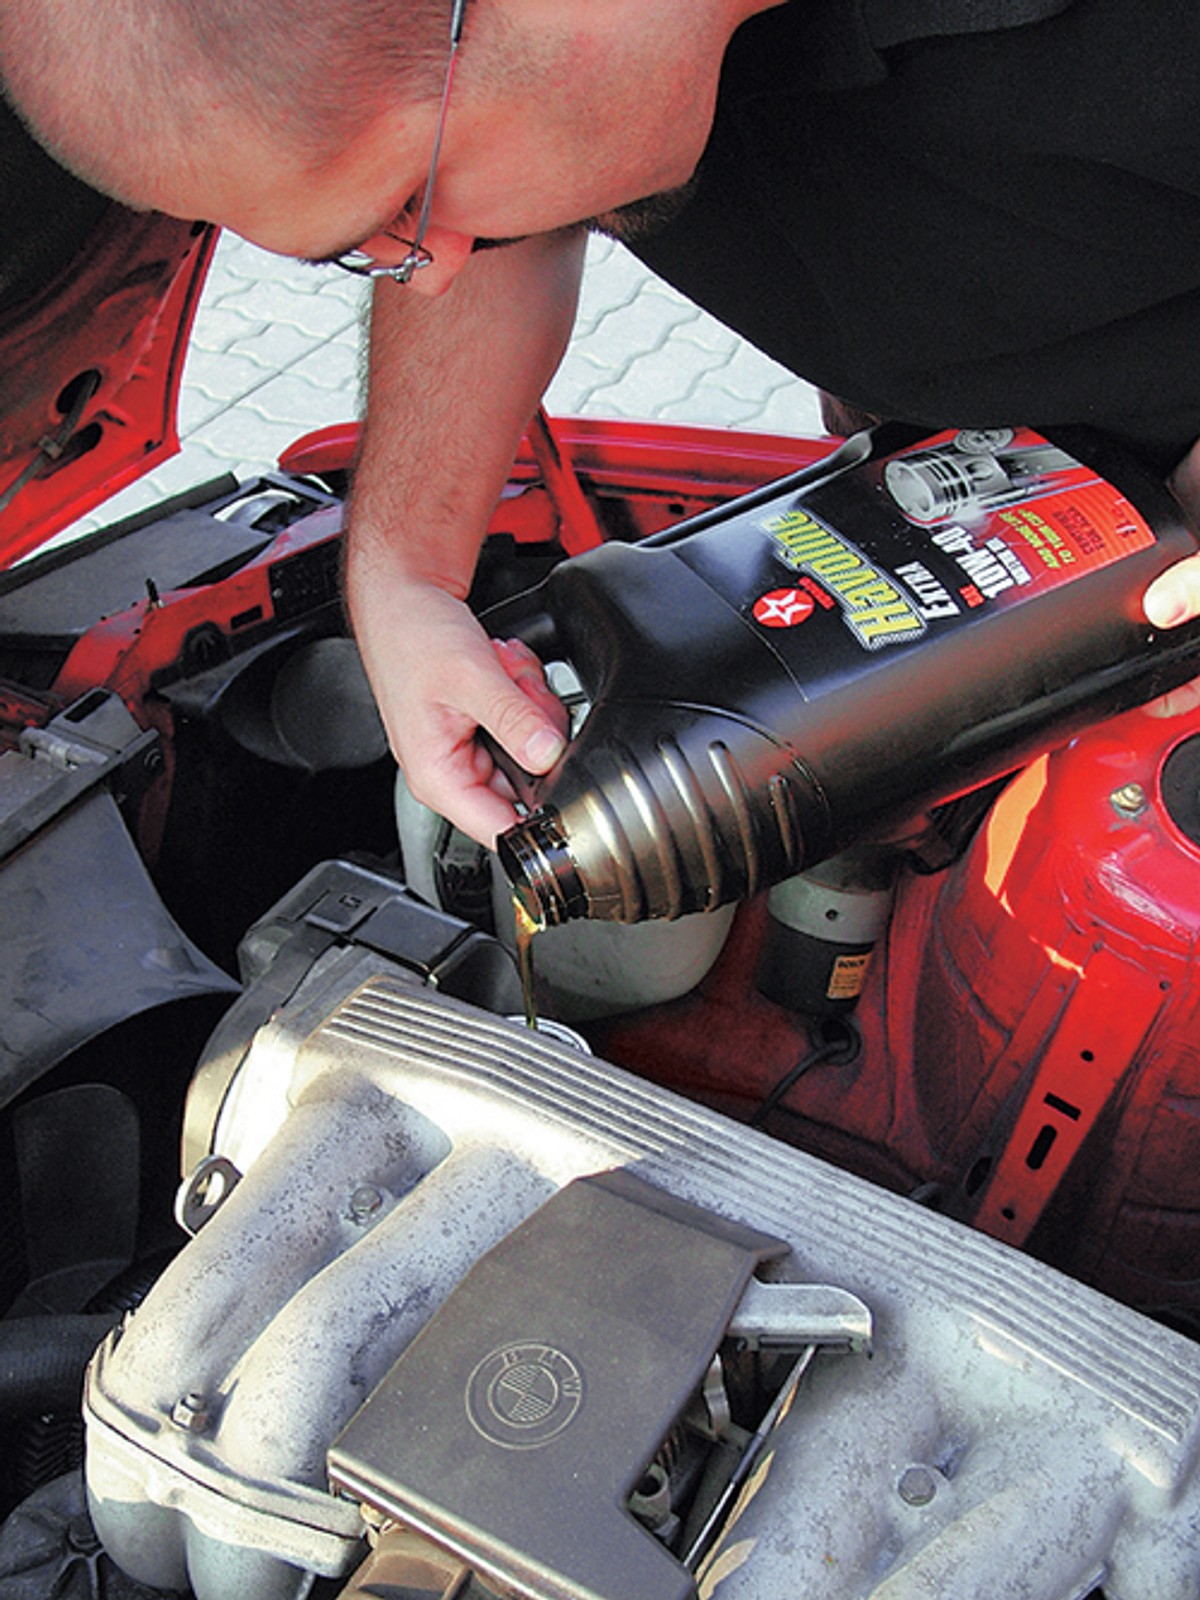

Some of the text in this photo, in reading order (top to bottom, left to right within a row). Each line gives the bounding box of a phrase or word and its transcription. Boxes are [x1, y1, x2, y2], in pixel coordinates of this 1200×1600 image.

[761, 510, 921, 638] Havoline
[894, 561, 961, 619] EXTRA
[931, 525, 1014, 599] 10W-40
[501, 1349, 581, 1397] BMW
